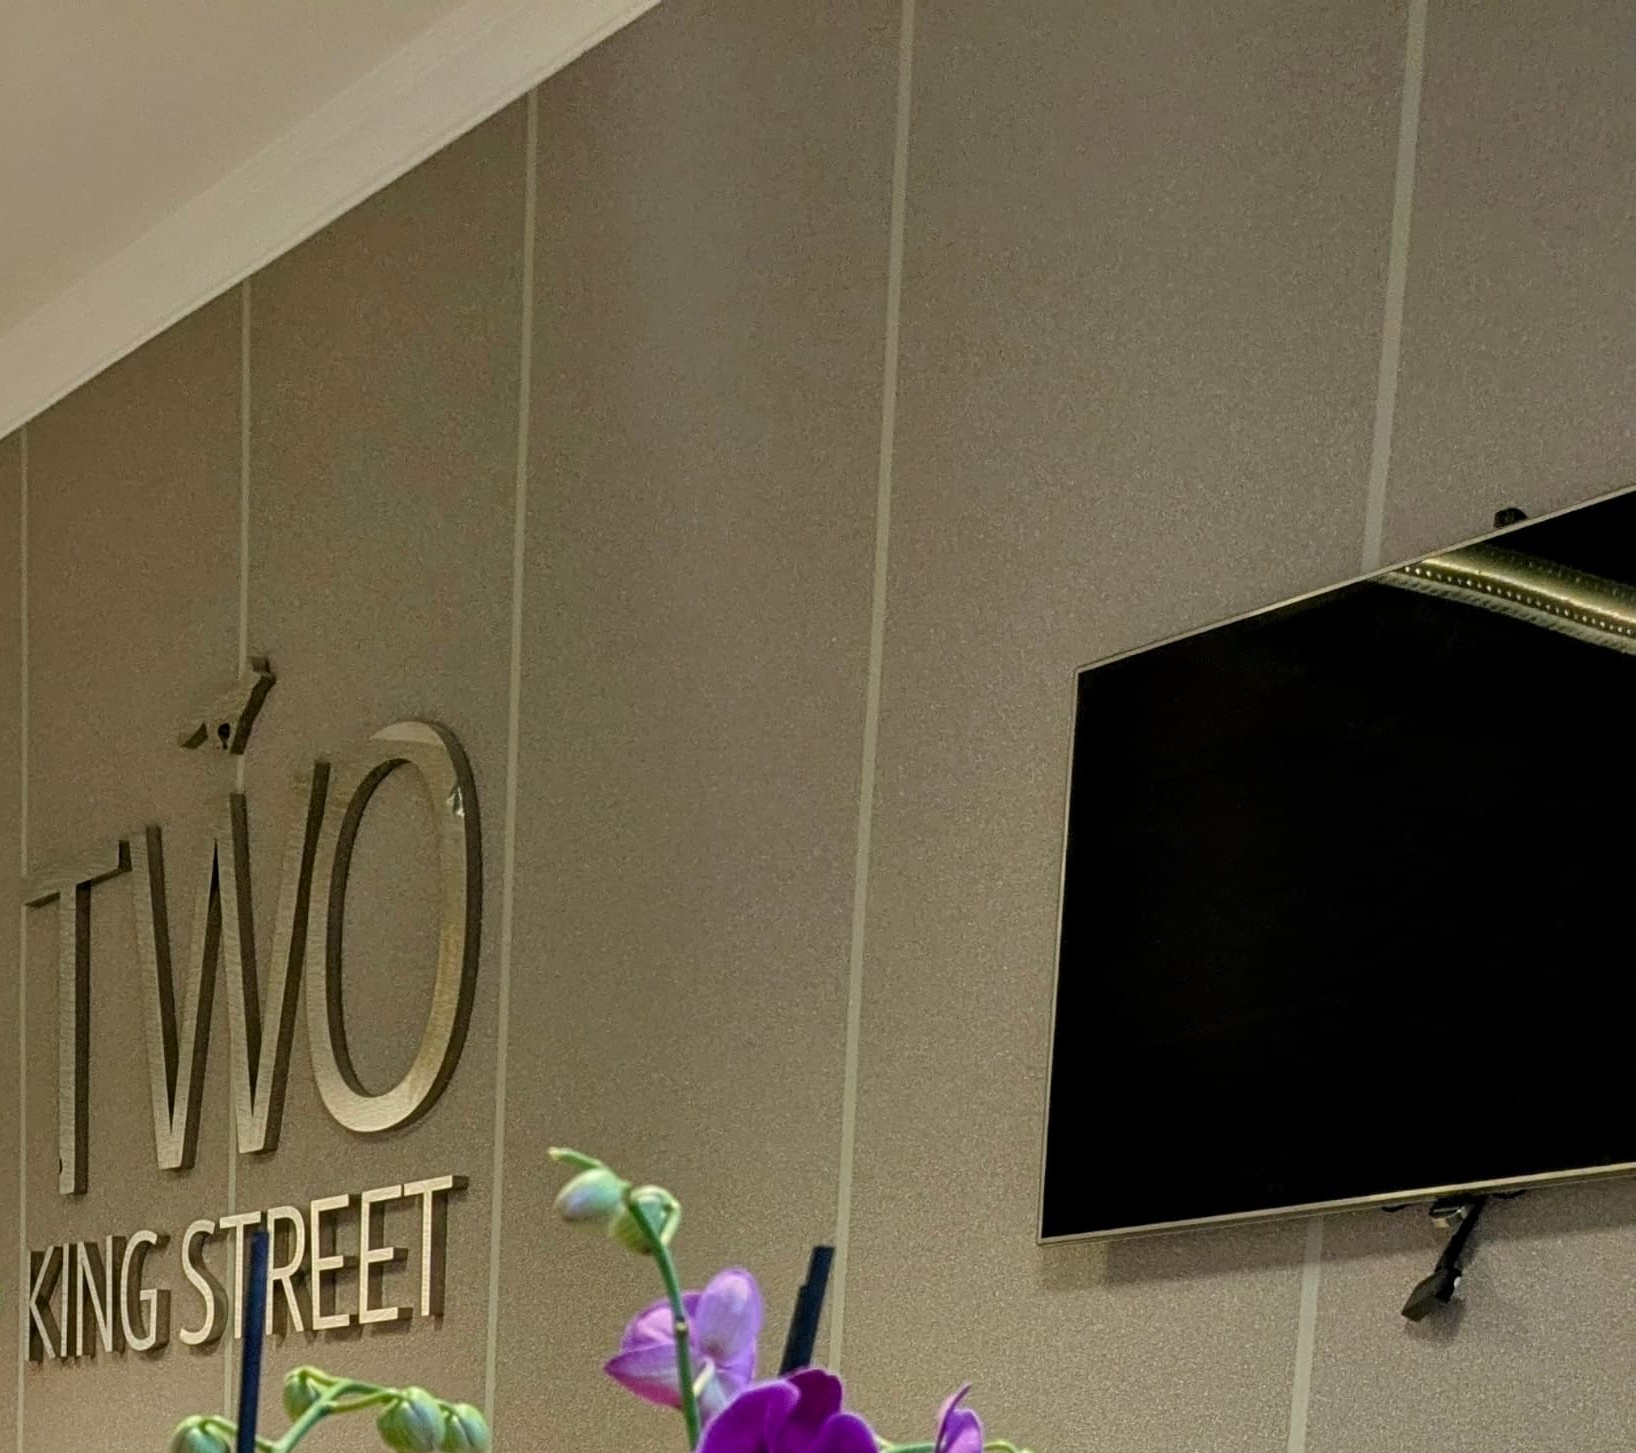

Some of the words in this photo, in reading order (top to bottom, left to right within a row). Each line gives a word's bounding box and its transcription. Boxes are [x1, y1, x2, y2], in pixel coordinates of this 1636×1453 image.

[22, 719, 484, 1195] TWO
[28, 1229, 170, 1363] KING
[179, 1175, 468, 1347] STREET
